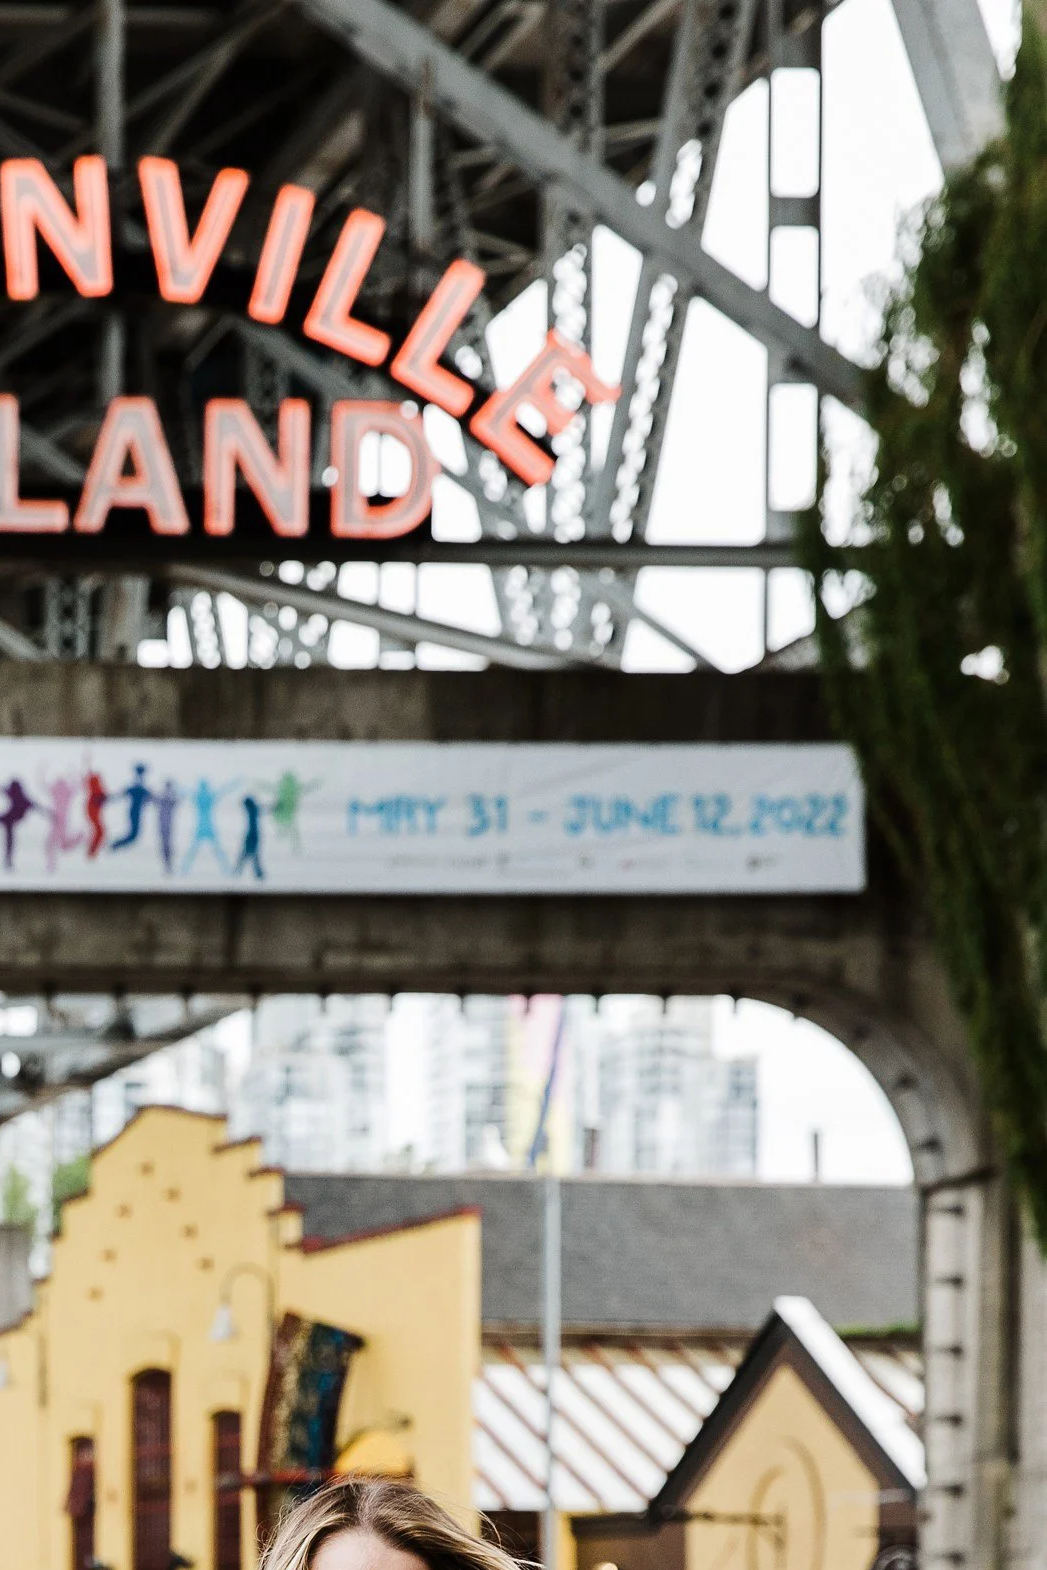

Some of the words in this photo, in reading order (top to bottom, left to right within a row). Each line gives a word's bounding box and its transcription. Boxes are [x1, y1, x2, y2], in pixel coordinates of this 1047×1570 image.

[347, 792, 444, 836] MAY
[467, 793, 508, 836] 31
[562, 793, 681, 836] JUNE
